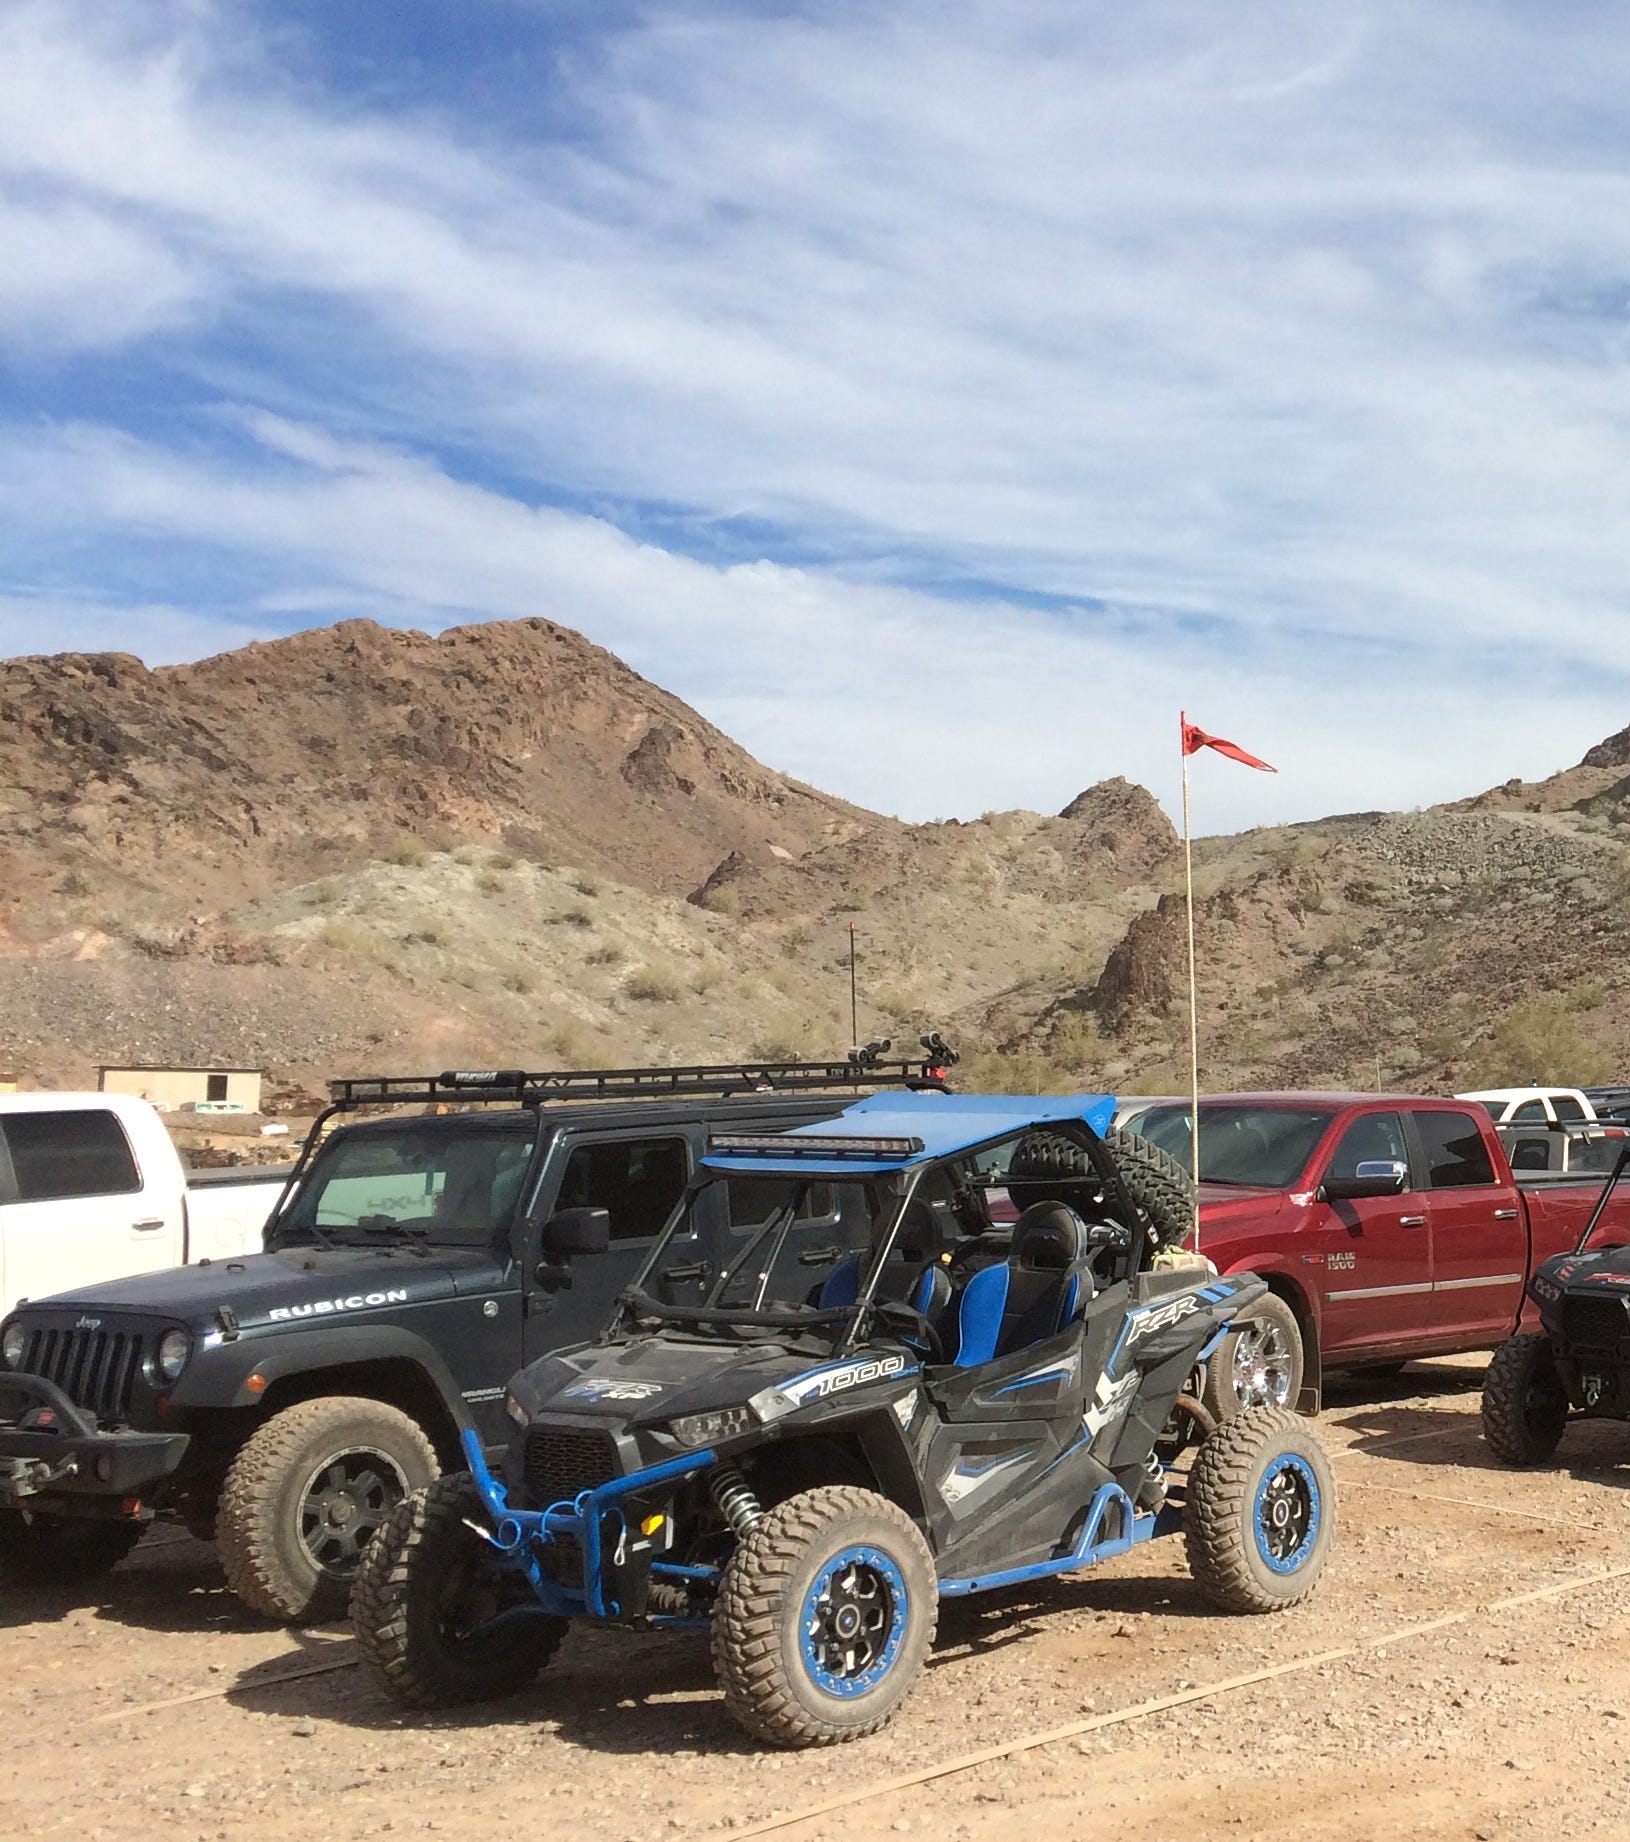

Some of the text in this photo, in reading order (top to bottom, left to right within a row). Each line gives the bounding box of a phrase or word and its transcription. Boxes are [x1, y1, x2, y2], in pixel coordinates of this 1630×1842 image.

[1327, 1252, 1356, 1262] RAM
[1327, 1261, 1355, 1271] 1500
[269, 1289, 408, 1320] RUBICON
[1126, 1296, 1200, 1346] RZR
[819, 1355, 904, 1397] 1000
[461, 1386, 507, 1398] WRANGL
[467, 1393, 505, 1403] UNLIMITE
